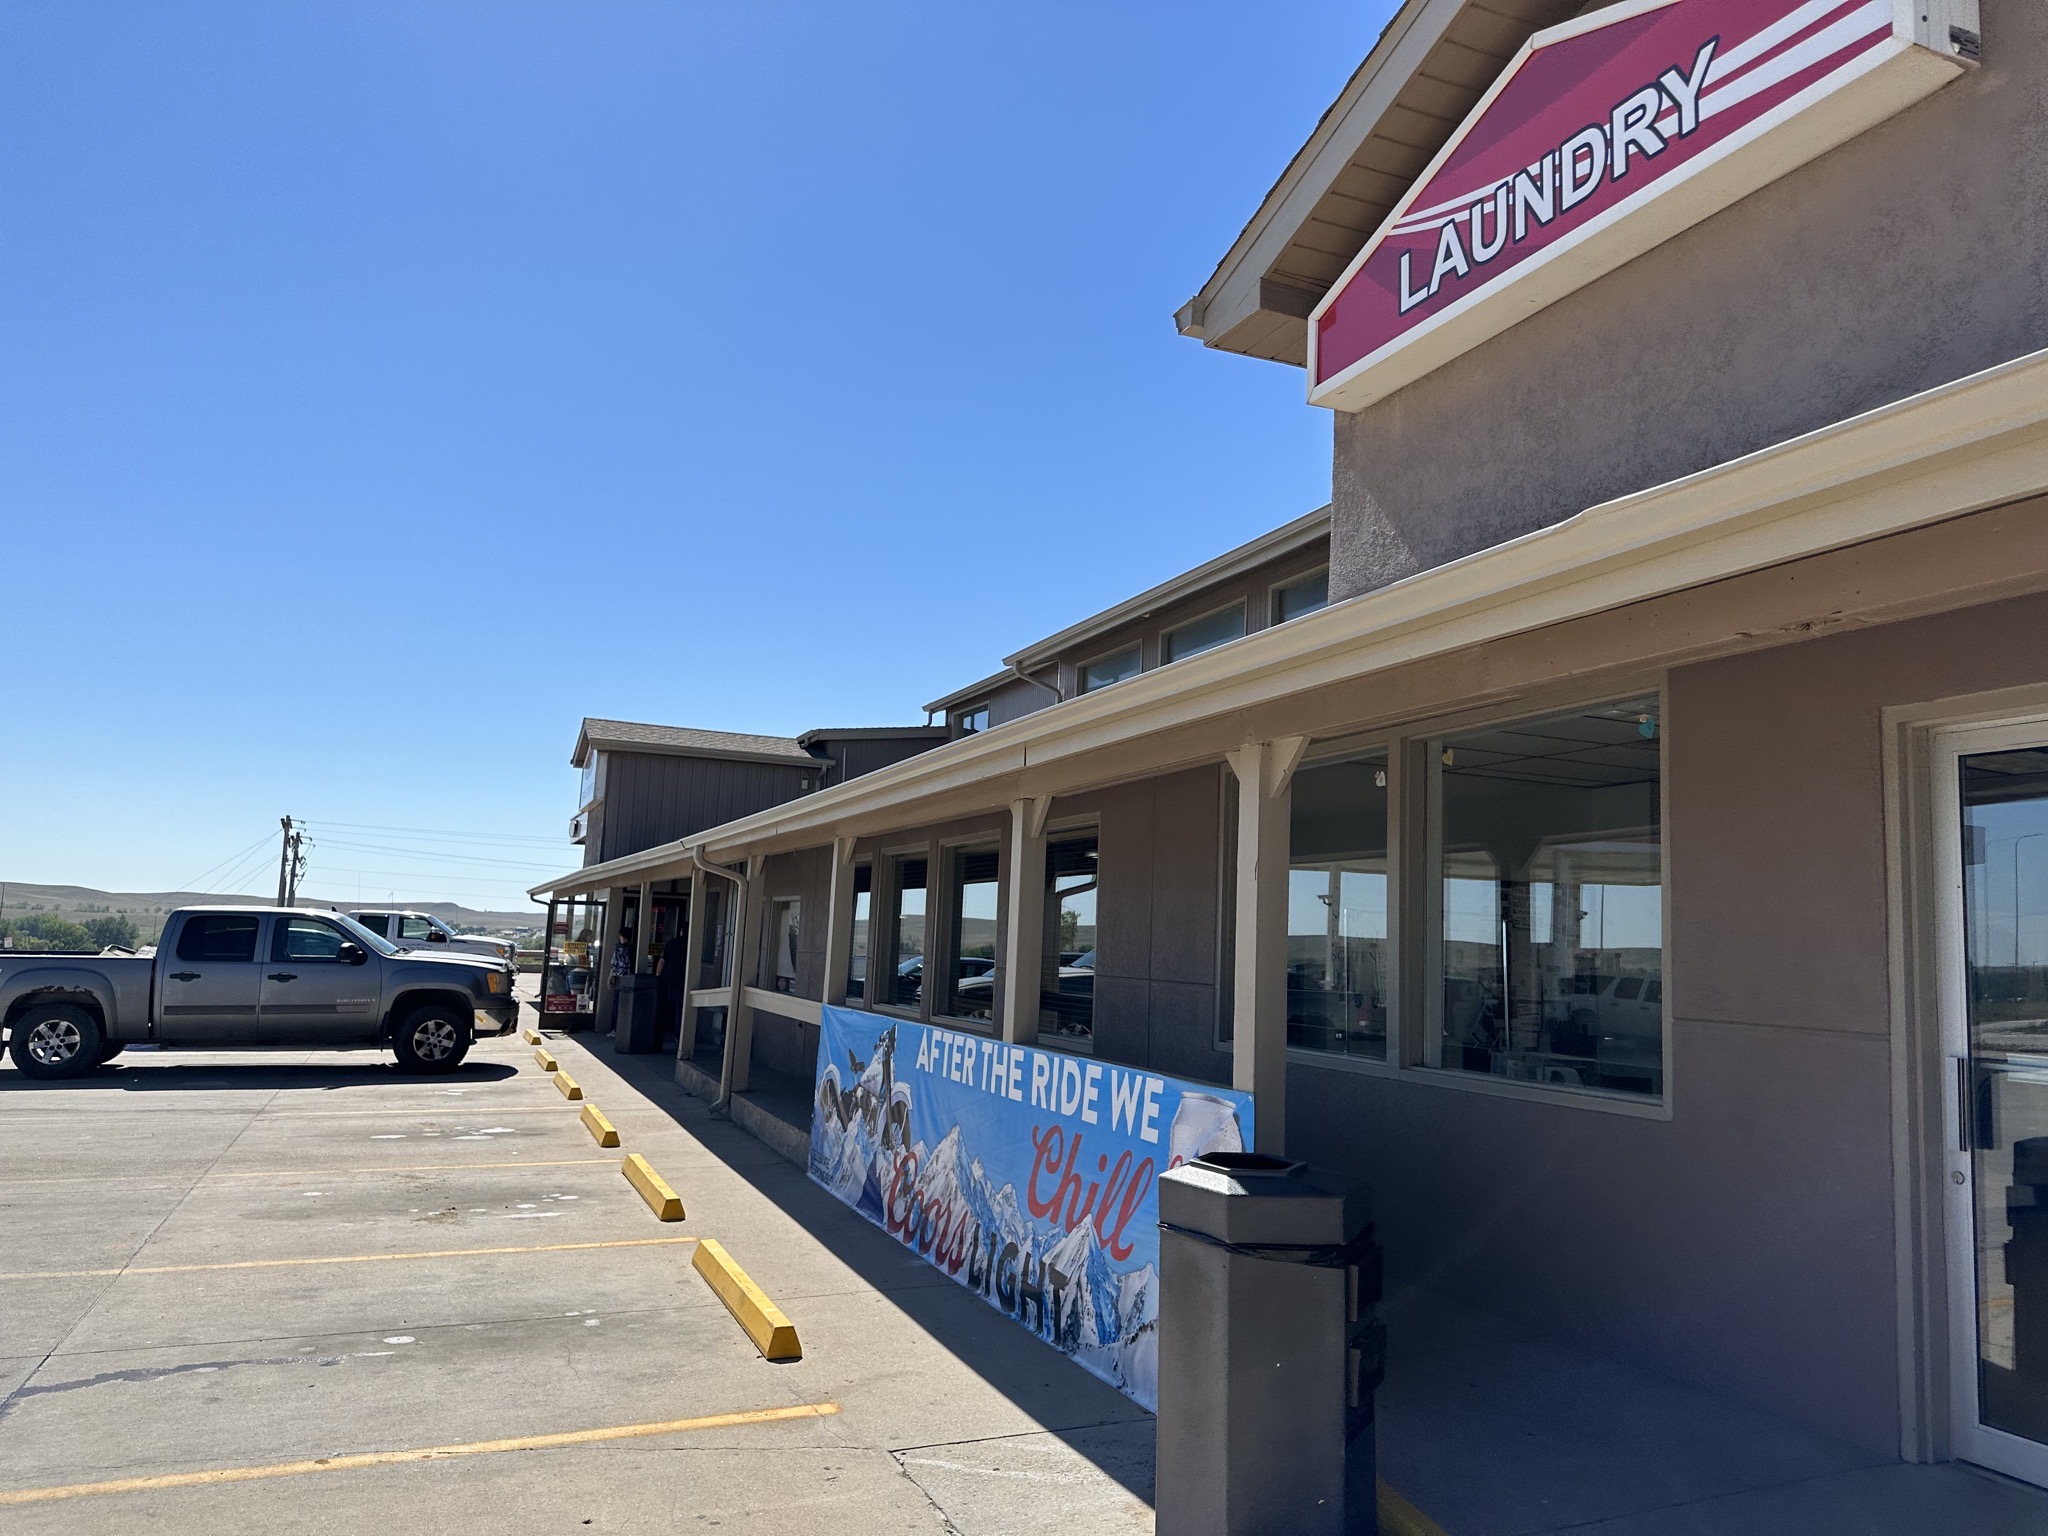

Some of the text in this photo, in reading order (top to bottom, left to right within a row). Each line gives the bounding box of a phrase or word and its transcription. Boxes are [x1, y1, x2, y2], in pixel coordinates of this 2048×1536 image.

[1399, 35, 1720, 317] LAUNDRY
[916, 1028, 1164, 1144] AFTER THE RIDE WE
[887, 1151, 1068, 1344] Coors LIGHT
[1027, 1125, 1154, 1262] Chill
